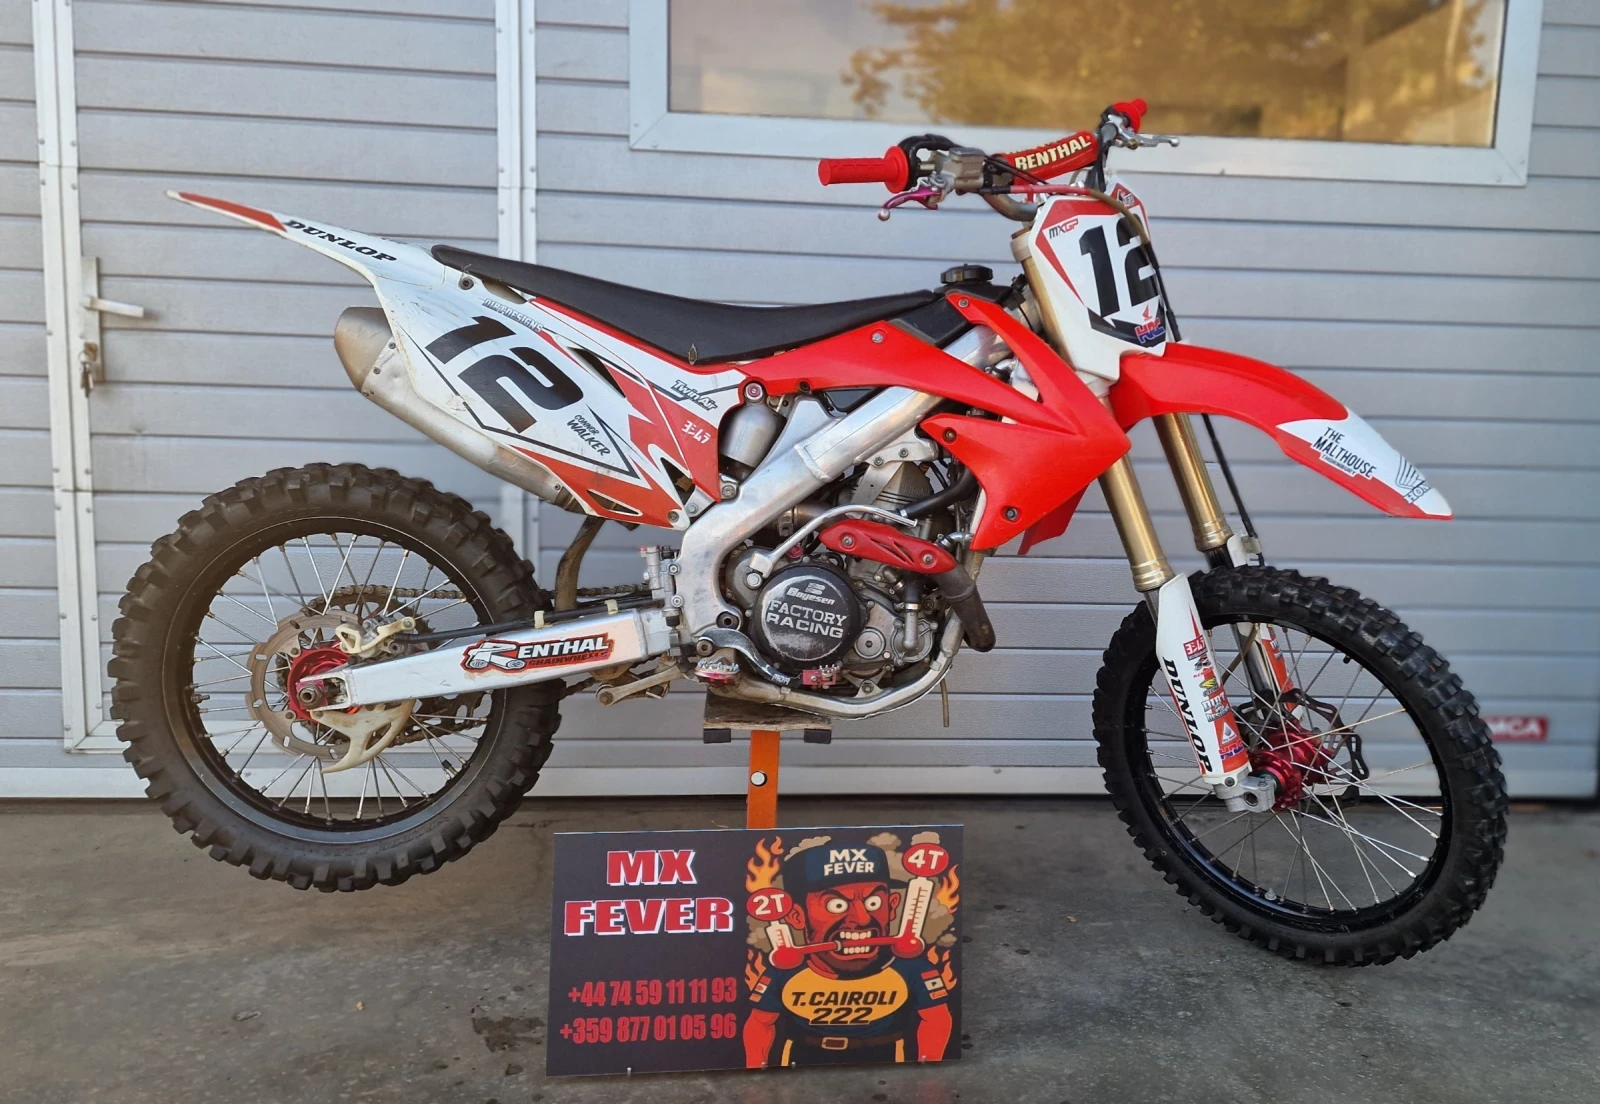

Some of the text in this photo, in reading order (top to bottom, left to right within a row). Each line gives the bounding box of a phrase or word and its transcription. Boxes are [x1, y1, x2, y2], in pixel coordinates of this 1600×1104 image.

[1014, 135, 1093, 171] RENTHAL
[283, 219, 398, 264] DUNLOP
[1049, 218, 1079, 240] MXGP
[1078, 212, 1160, 318] 12
[425, 315, 584, 434] 12
[671, 379, 718, 412] Twin Air
[566, 418, 611, 457] WALKER
[573, 413, 601, 436] CONNOR
[1322, 426, 1346, 444] THE
[1312, 436, 1378, 479] MALTHOUSE
[786, 586, 836, 606] Boyesen
[765, 612, 845, 639] RACING
[768, 600, 848, 627] FACTORY
[467, 636, 609, 670] RENTHAL
[1162, 656, 1213, 773] DUNLOP
[606, 849, 698, 886] MX
[824, 861, 875, 876] FEVER
[829, 848, 868, 862] MX
[907, 849, 944, 870] 4T
[563, 896, 734, 936] FEVER
[752, 893, 785, 916] 2T
[568, 976, 737, 1007] +44 74 59 11 11 93
[560, 1013, 737, 1044] +359 877 01 05 96
[809, 1006, 873, 1025] 222
